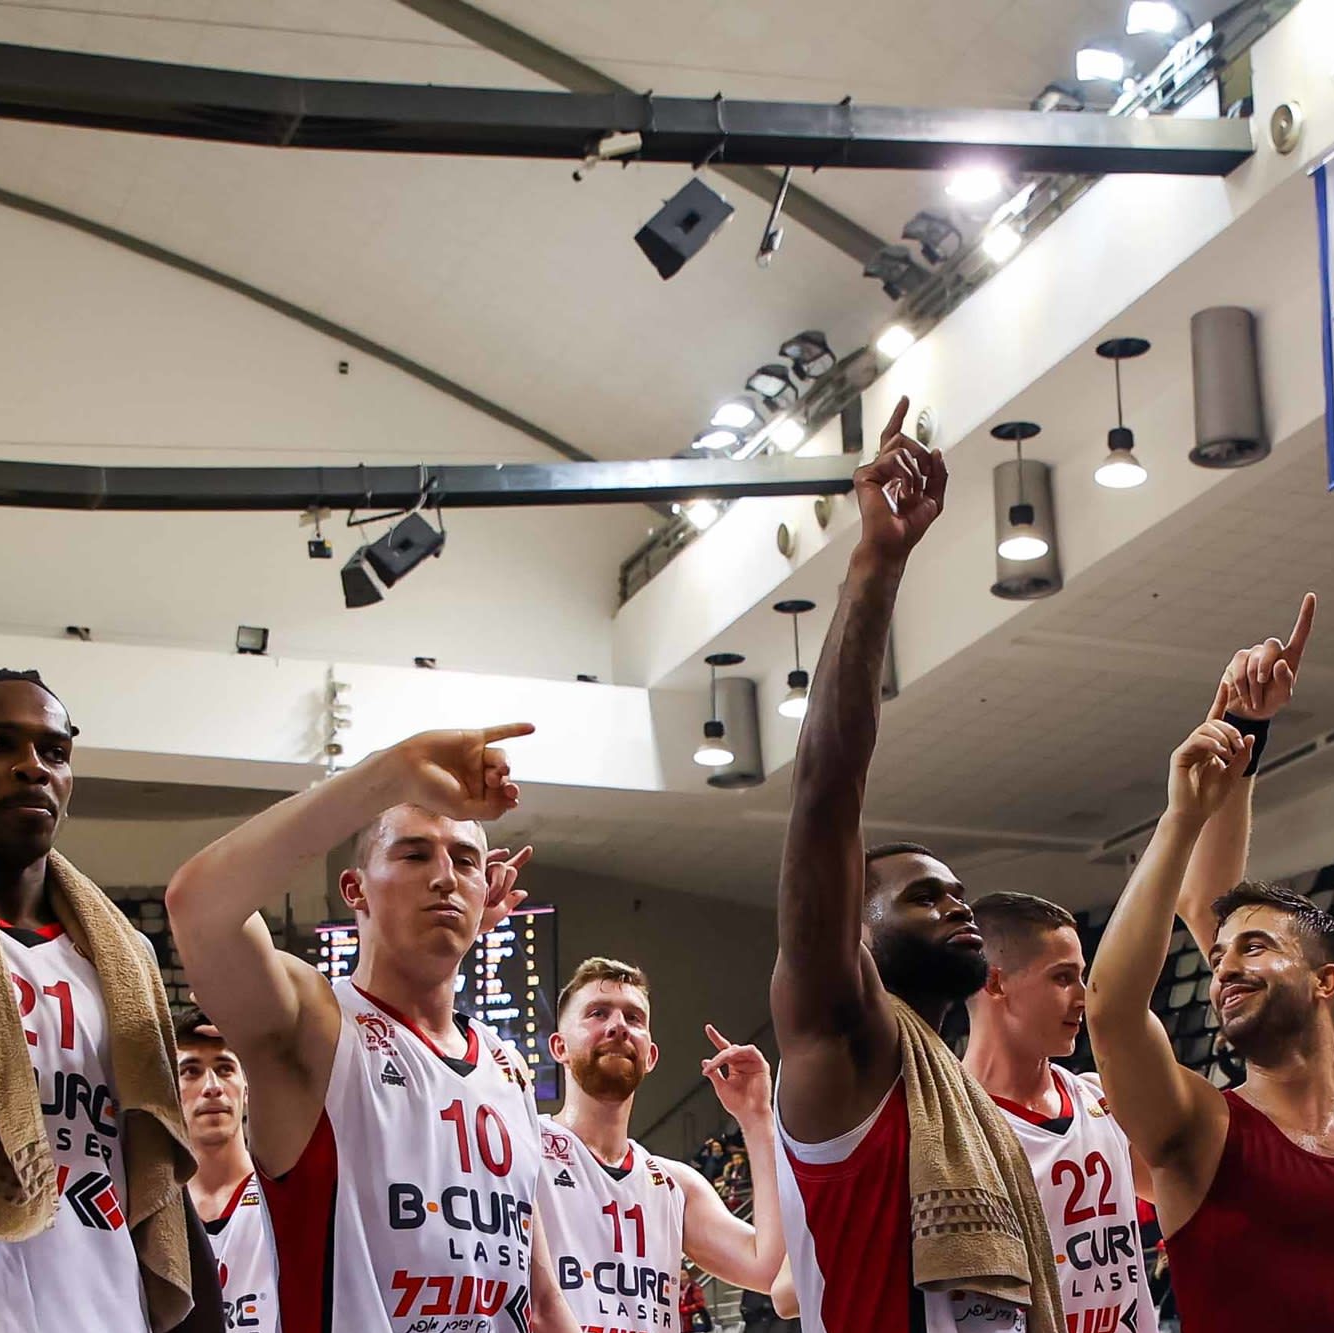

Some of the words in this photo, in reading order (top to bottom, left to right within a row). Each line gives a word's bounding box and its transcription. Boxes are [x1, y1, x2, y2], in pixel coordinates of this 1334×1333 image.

[41, 1072, 117, 1137] URE
[56, 1128, 113, 1170] SER
[440, 1099, 512, 1177] 10
[1051, 1151, 1117, 1225] 22
[389, 1183, 533, 1246] B-CURE
[602, 1200, 646, 1258] 11
[449, 1238, 530, 1272] LASE
[1056, 1221, 1135, 1271] -CUR
[392, 1270, 508, 1317] שובל
[559, 1256, 671, 1307] B-CURE
[1072, 1264, 1137, 1296] LASE
[599, 1298, 671, 1329] LASER
